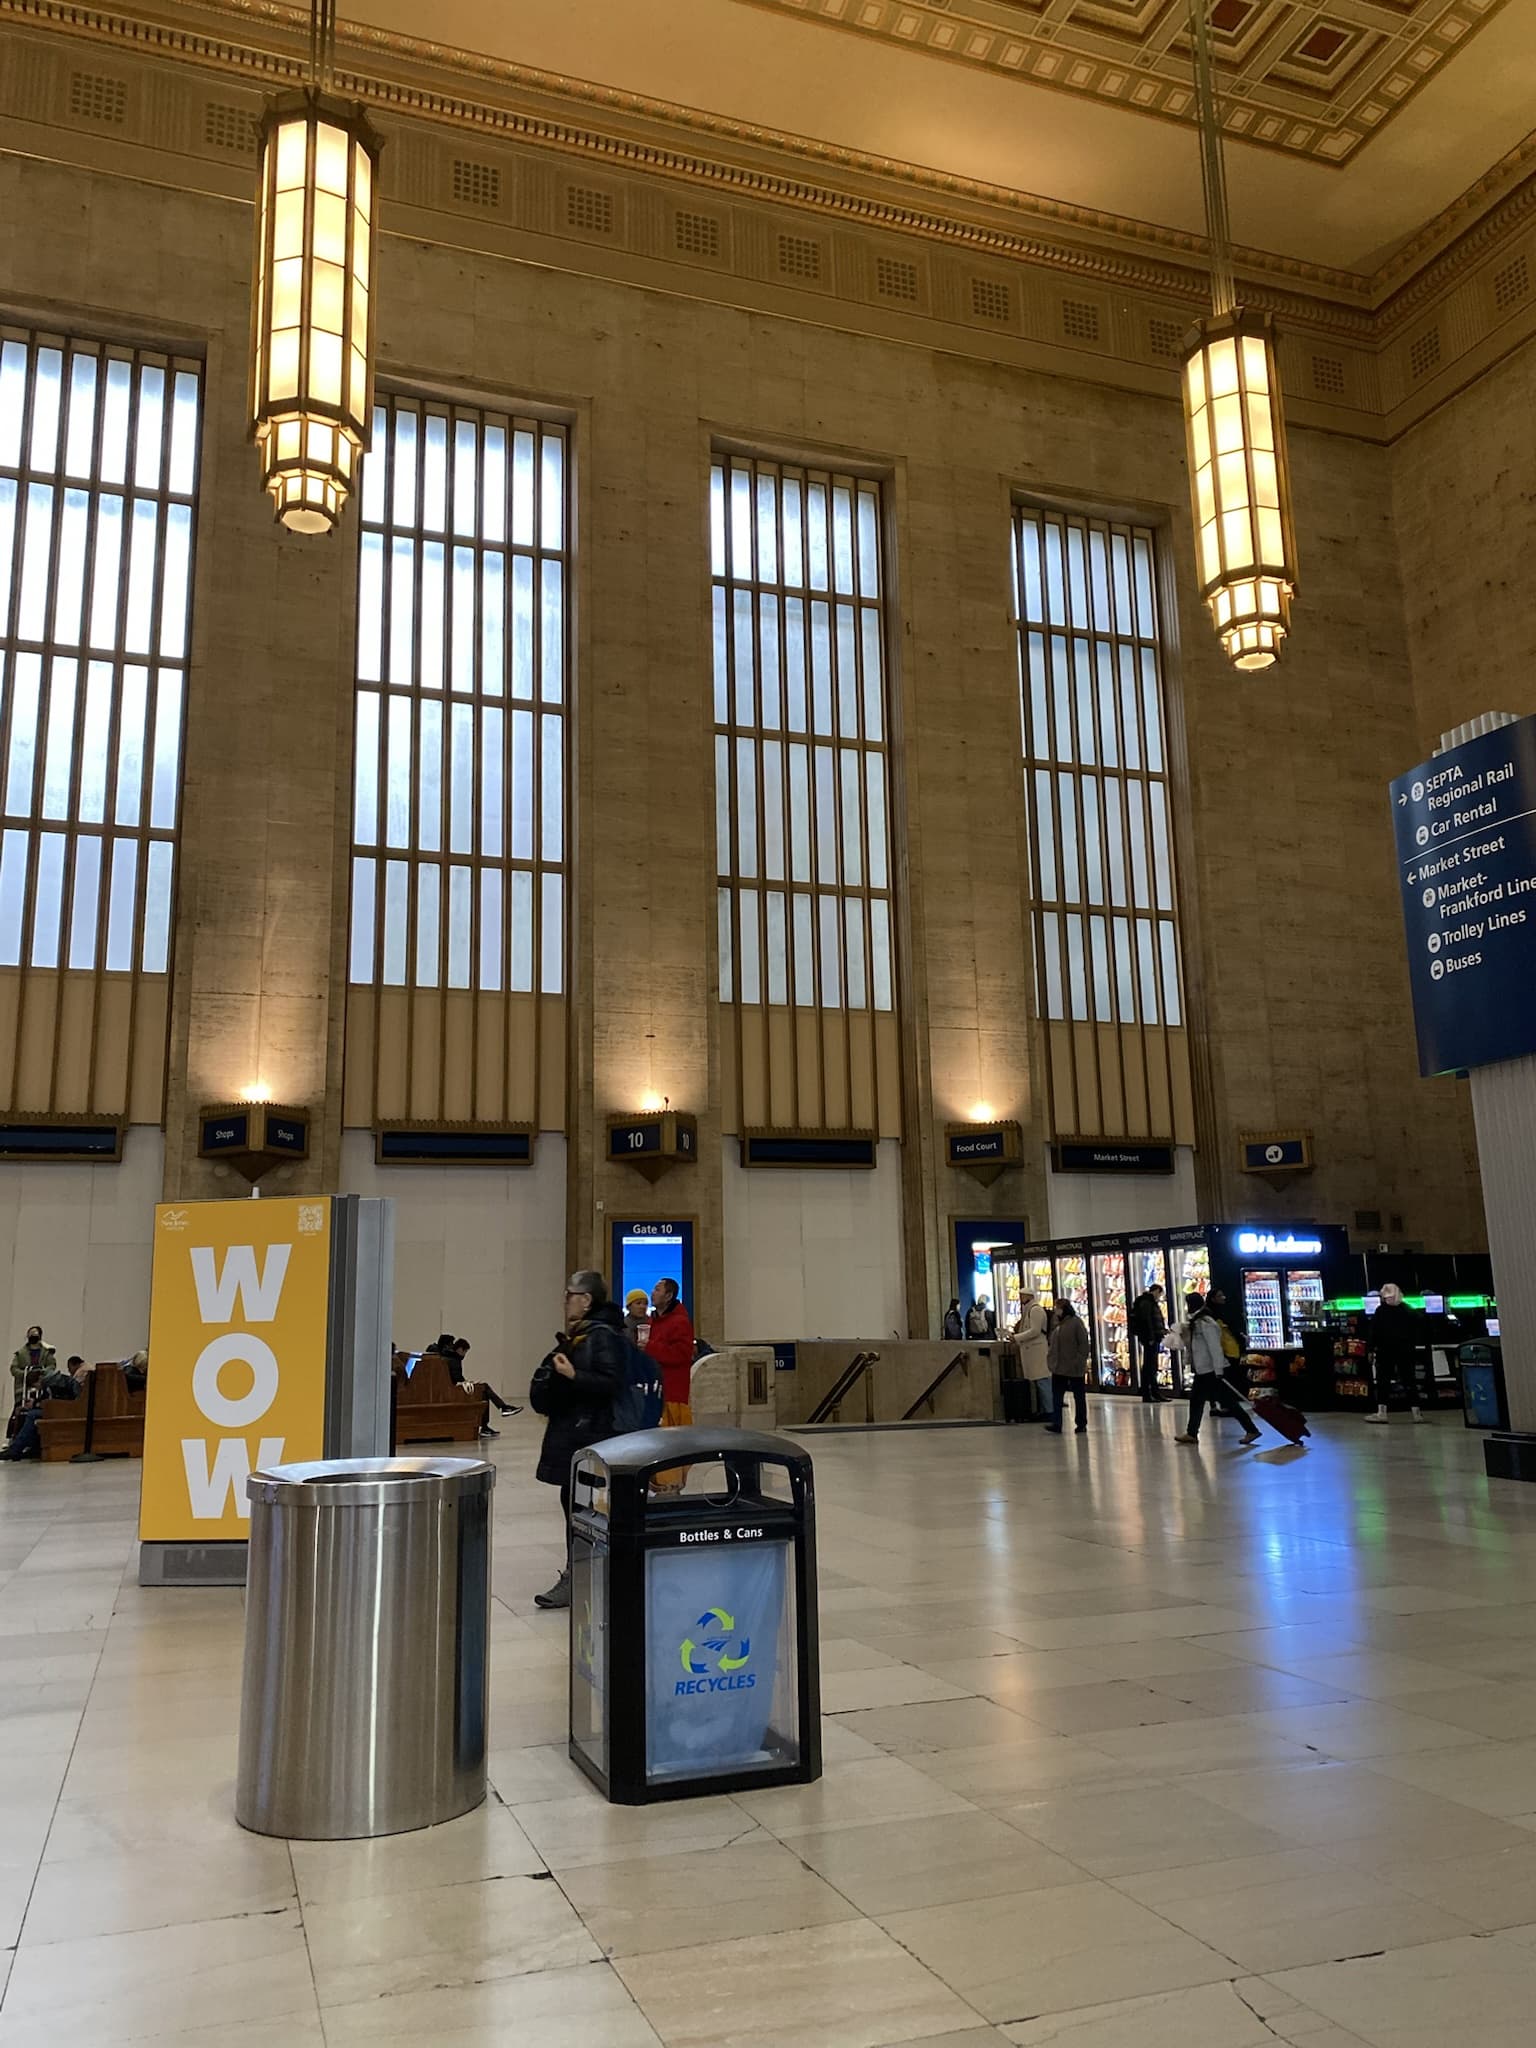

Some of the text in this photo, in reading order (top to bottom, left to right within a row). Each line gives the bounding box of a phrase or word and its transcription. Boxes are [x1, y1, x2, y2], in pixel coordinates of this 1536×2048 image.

[1426, 765, 1463, 793] SEPTA
[1428, 762, 1514, 811] Regional Rail
[1431, 797, 1497, 836] Car Rental
[1419, 836, 1505, 881] Market Street
[1438, 872, 1488, 900] Market-
[1440, 883, 1503, 919] Frankford
[1442, 909, 1527, 945] Trolley Lines
[1445, 952, 1482, 973] Buses
[215, 1130, 235, 1140] Shops
[277, 1129, 294, 1142] Shops
[627, 1131, 644, 1149] 10
[682, 1133, 690, 1150] 10
[956, 1141, 997, 1153] Food Court
[1093, 1153, 1140, 1162] Market Street
[632, 1224, 673, 1234] Gate 10
[1169, 1230, 1204, 1241] MARKETPLACE
[679, 1527, 763, 1543] Bottles & Cans
[674, 1673, 756, 1696] RECYCLES
